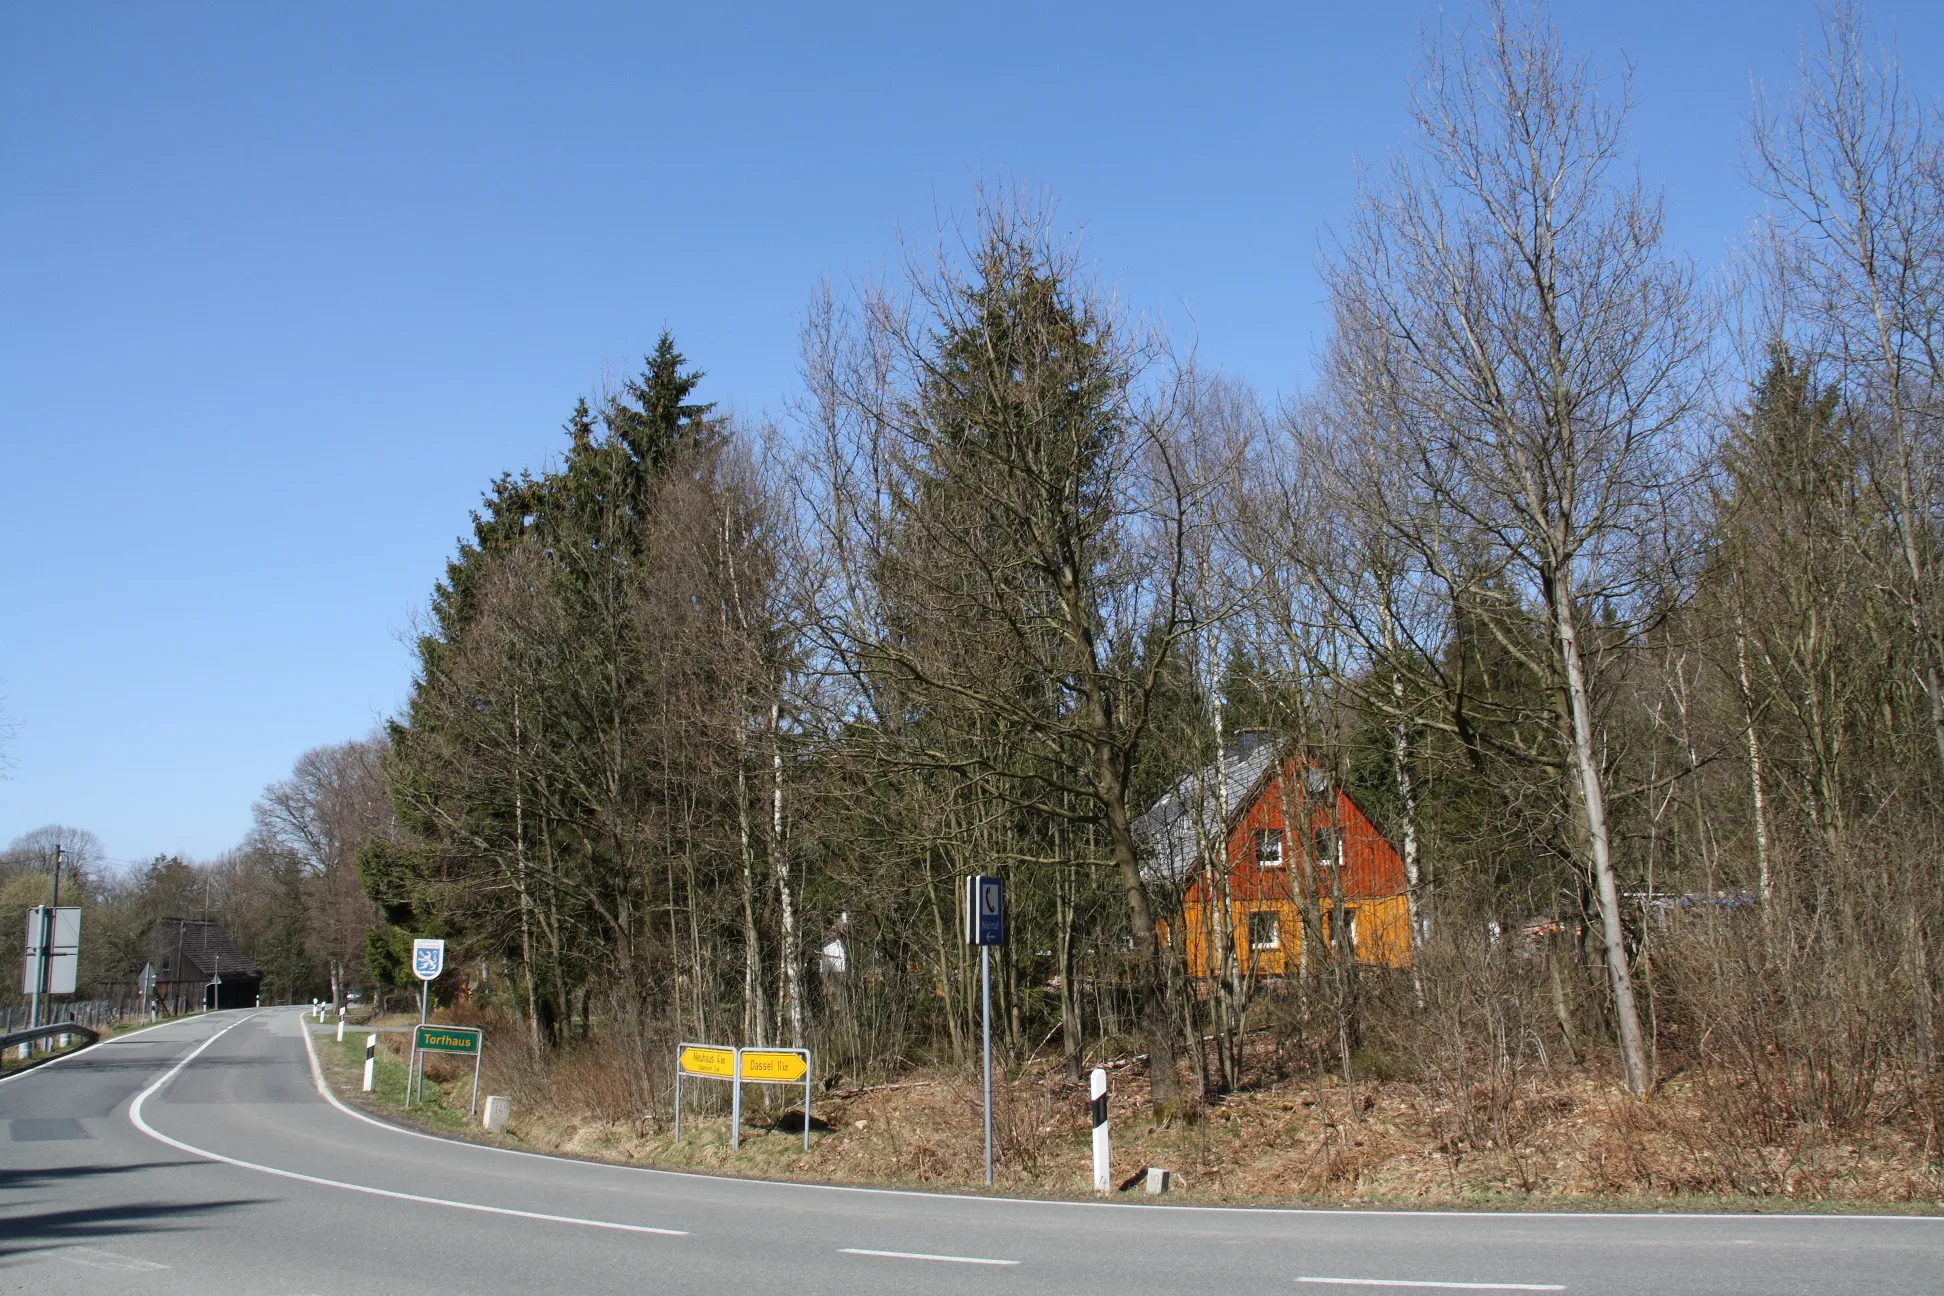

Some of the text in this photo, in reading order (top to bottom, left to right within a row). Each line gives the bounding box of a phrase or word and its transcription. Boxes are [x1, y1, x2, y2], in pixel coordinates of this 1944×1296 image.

[424, 1033, 471, 1047] Torfhaus
[693, 1052, 714, 1064] Neuhaus
[750, 1059, 774, 1071] Dassel
